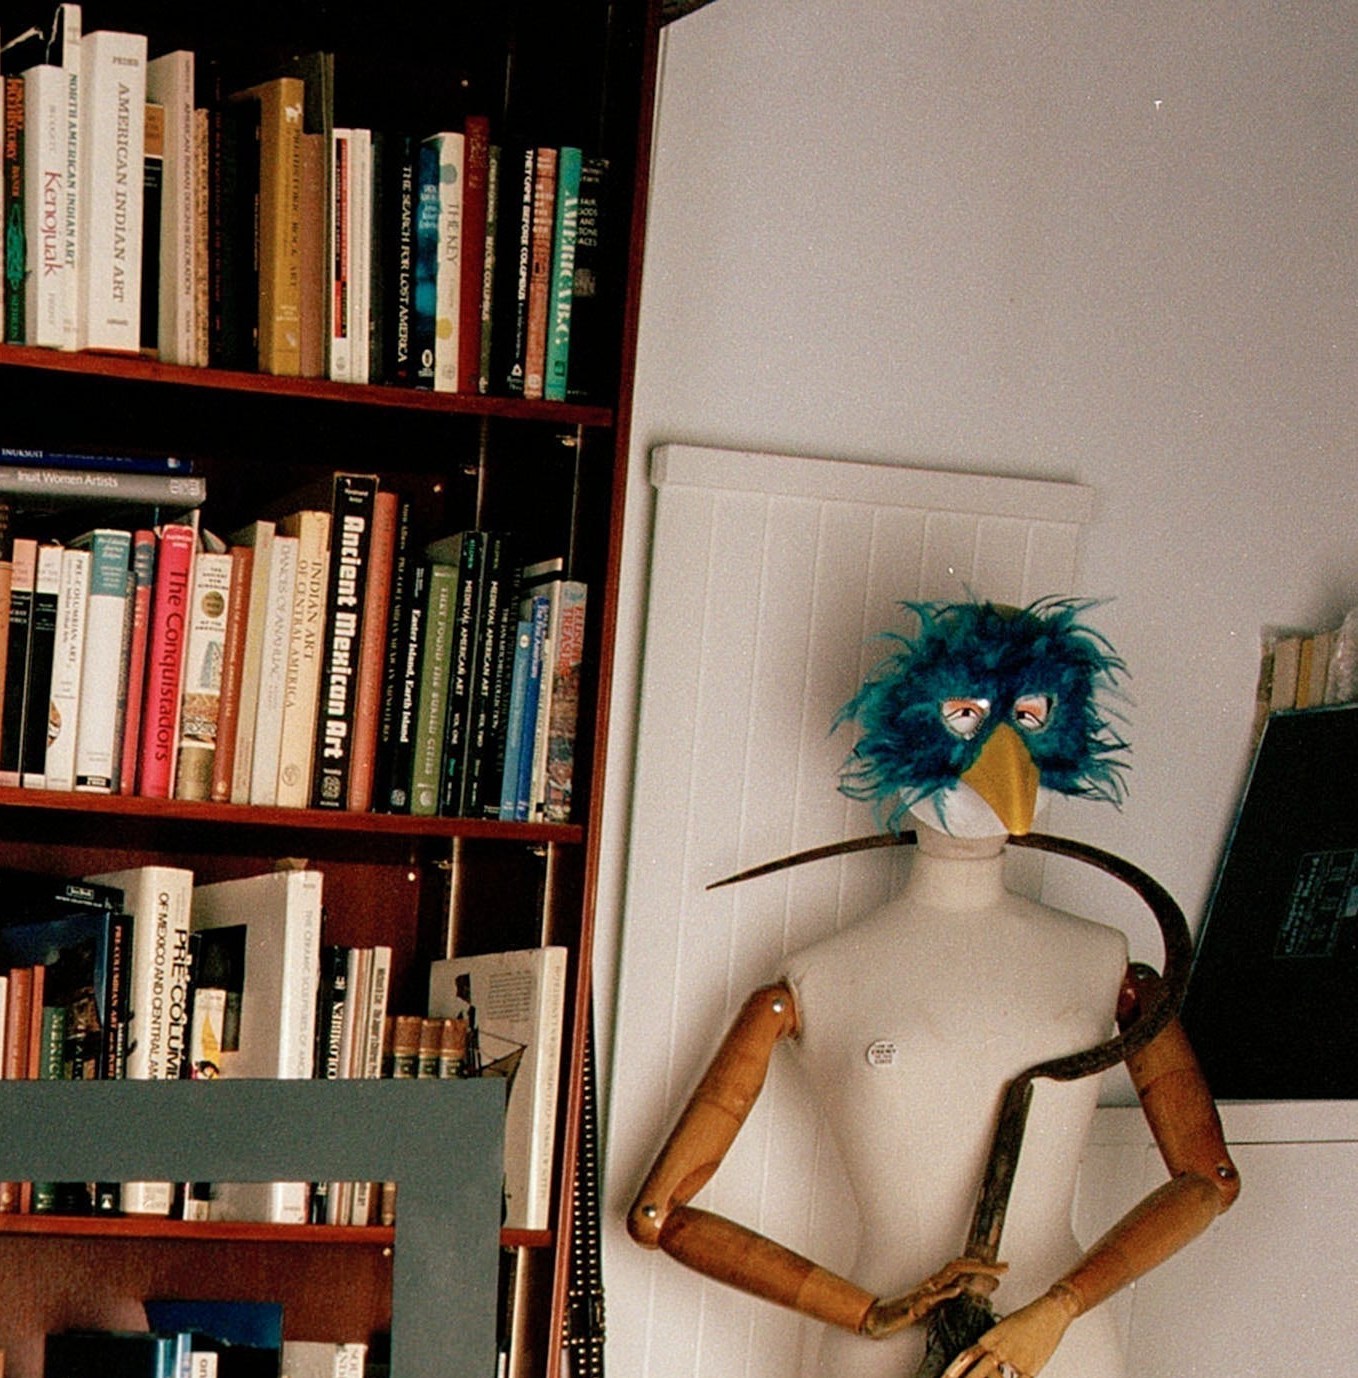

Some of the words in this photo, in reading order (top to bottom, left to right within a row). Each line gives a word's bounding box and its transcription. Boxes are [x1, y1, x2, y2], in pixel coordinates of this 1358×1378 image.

[68, 73, 78, 114] NORTH
[67, 118, 77, 182] AMERICAN
[117, 82, 131, 171] AMERICAN
[42, 170, 63, 278] Kenojuak
[65, 183, 76, 239] INDIAN
[115, 179, 128, 262] INDIAN
[401, 193, 411, 245] SEARCH
[64, 243, 75, 269] ART
[112, 265, 128, 302] ART
[397, 310, 408, 364] AMERICA
[1, 447, 44, 459] INUKSUIT
[17, 470, 42, 484] Inuit
[42, 471, 82, 486] Women
[83, 474, 119, 488] Artists
[336, 515, 365, 607] Ancient
[169, 568, 187, 611] The
[155, 613, 183, 762] Conquistadors
[327, 612, 358, 716] Mexican
[324, 721, 348, 759] Art
